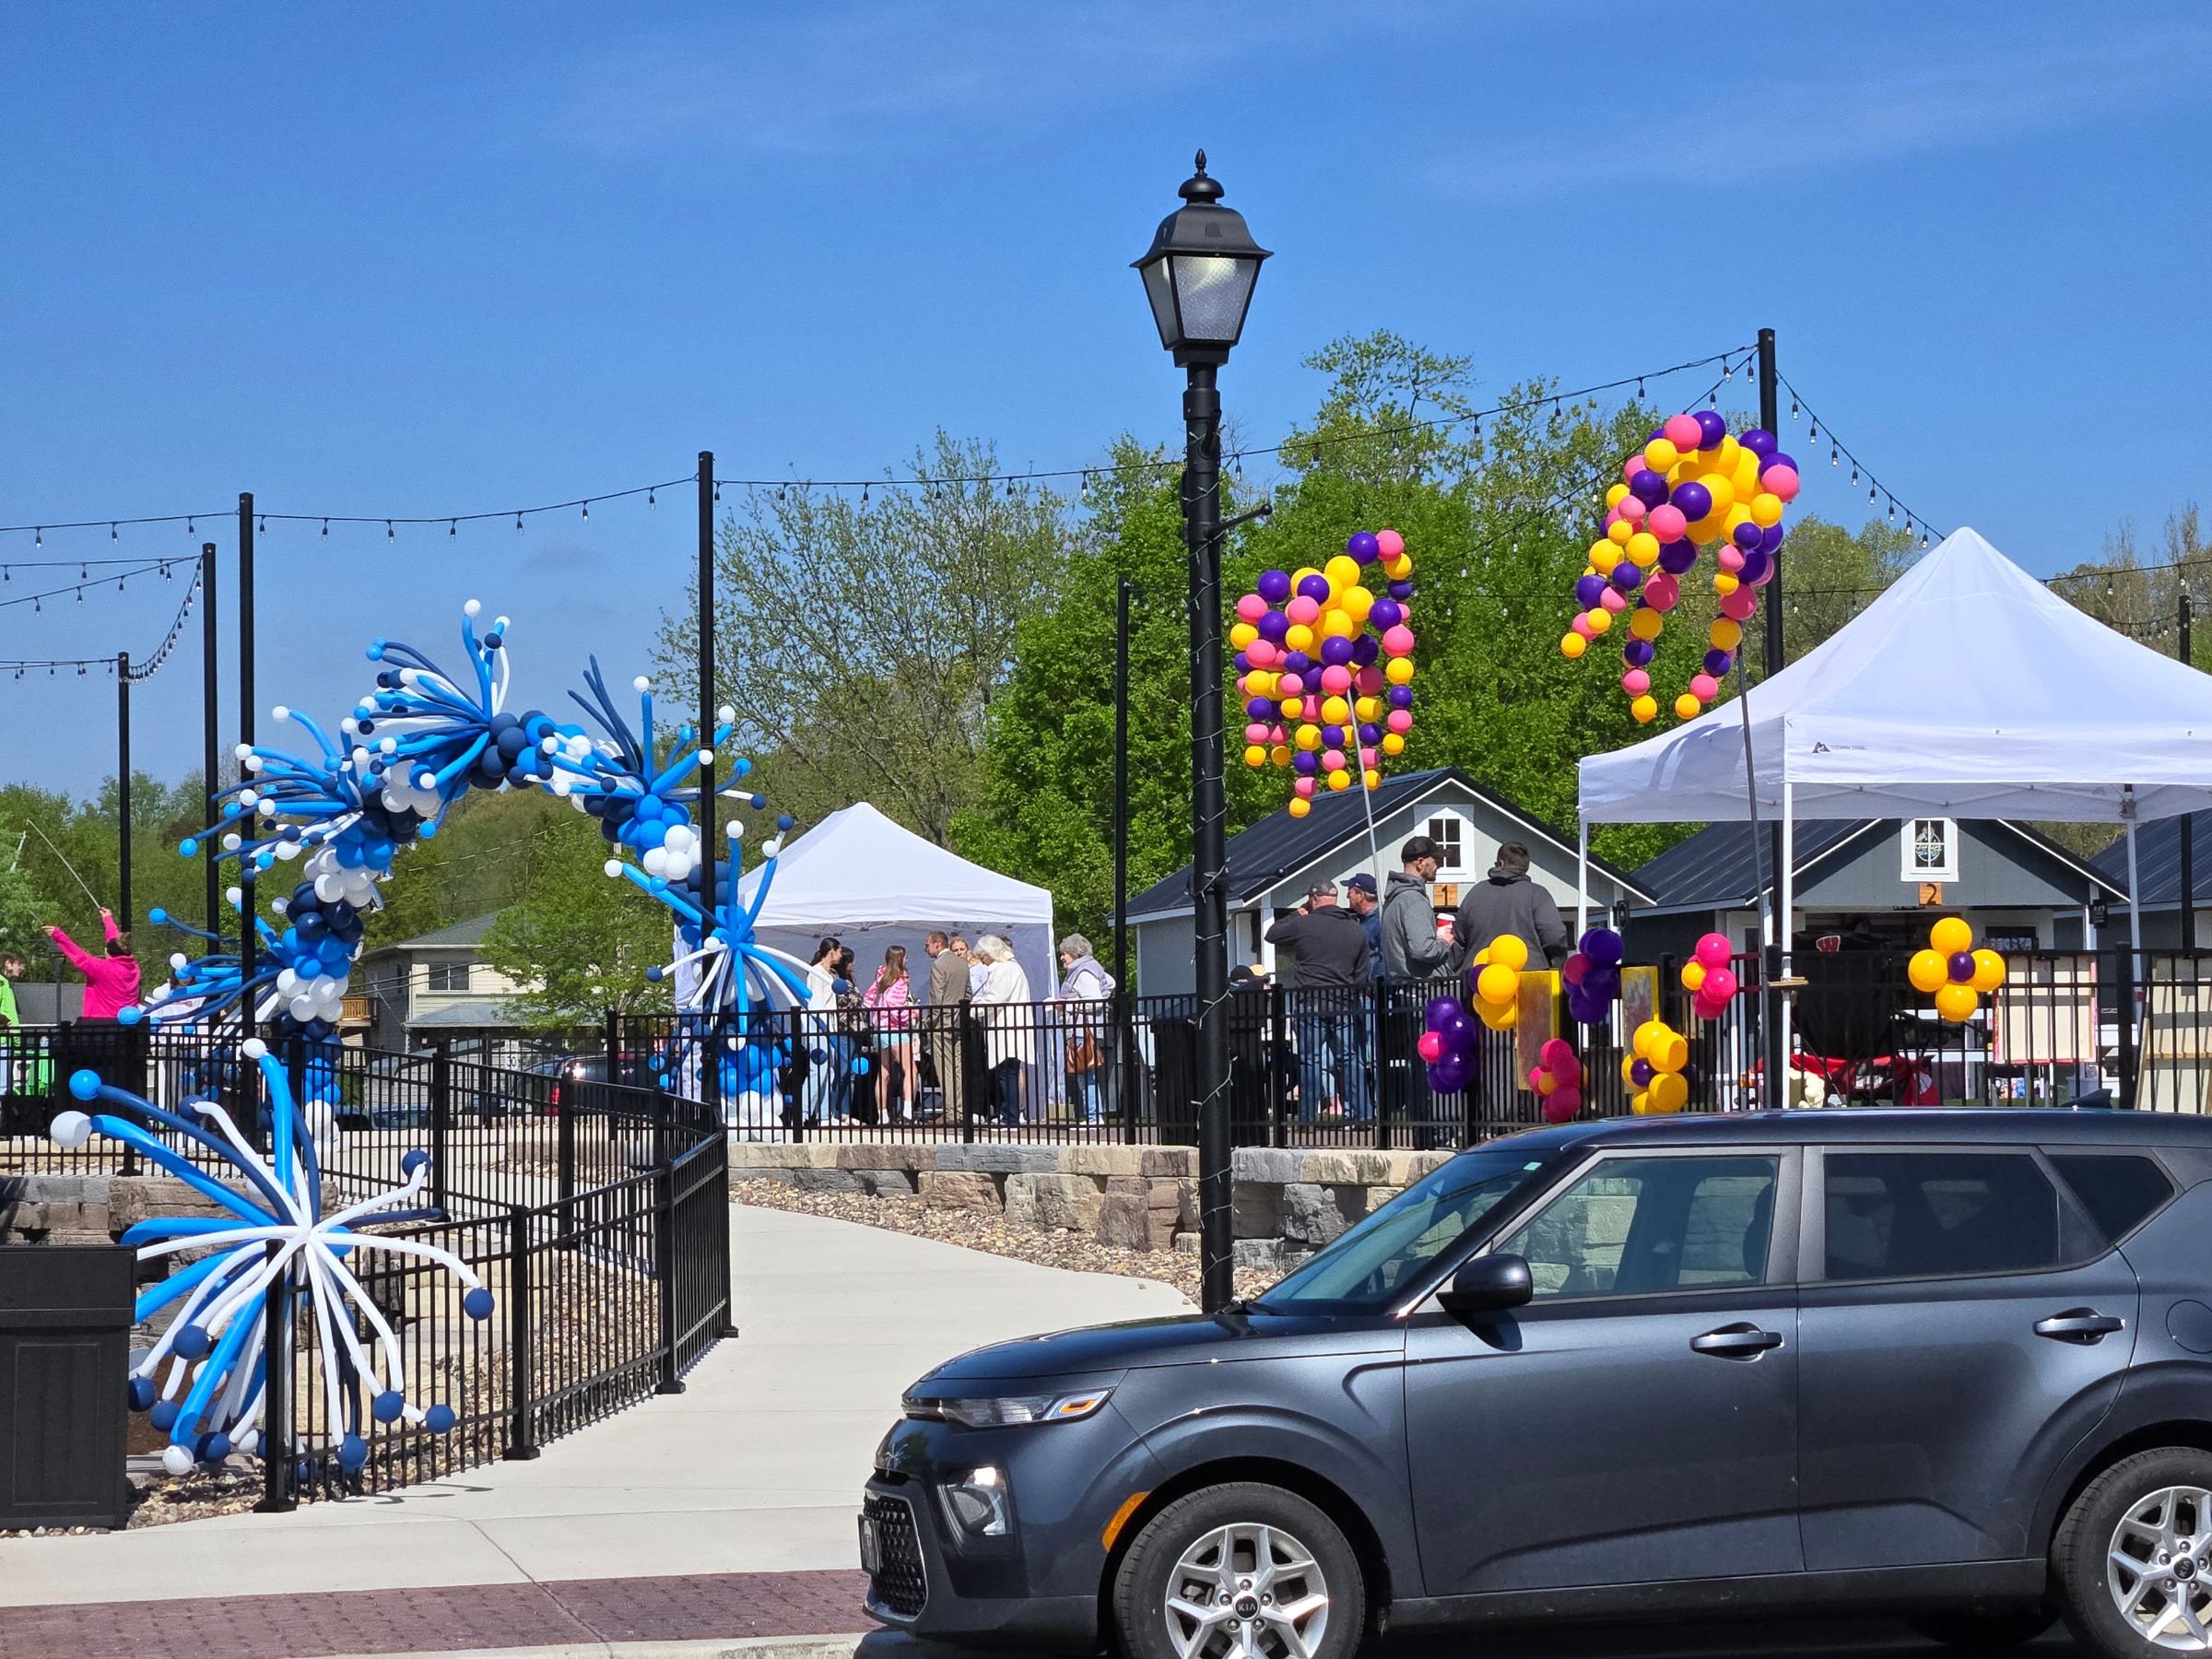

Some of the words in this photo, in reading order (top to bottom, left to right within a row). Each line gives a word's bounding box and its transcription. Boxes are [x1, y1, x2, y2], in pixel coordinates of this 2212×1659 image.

[1441, 884, 1448, 906] 1
[1926, 883, 1937, 905] 2
[1238, 1603, 1256, 1612] KIA
